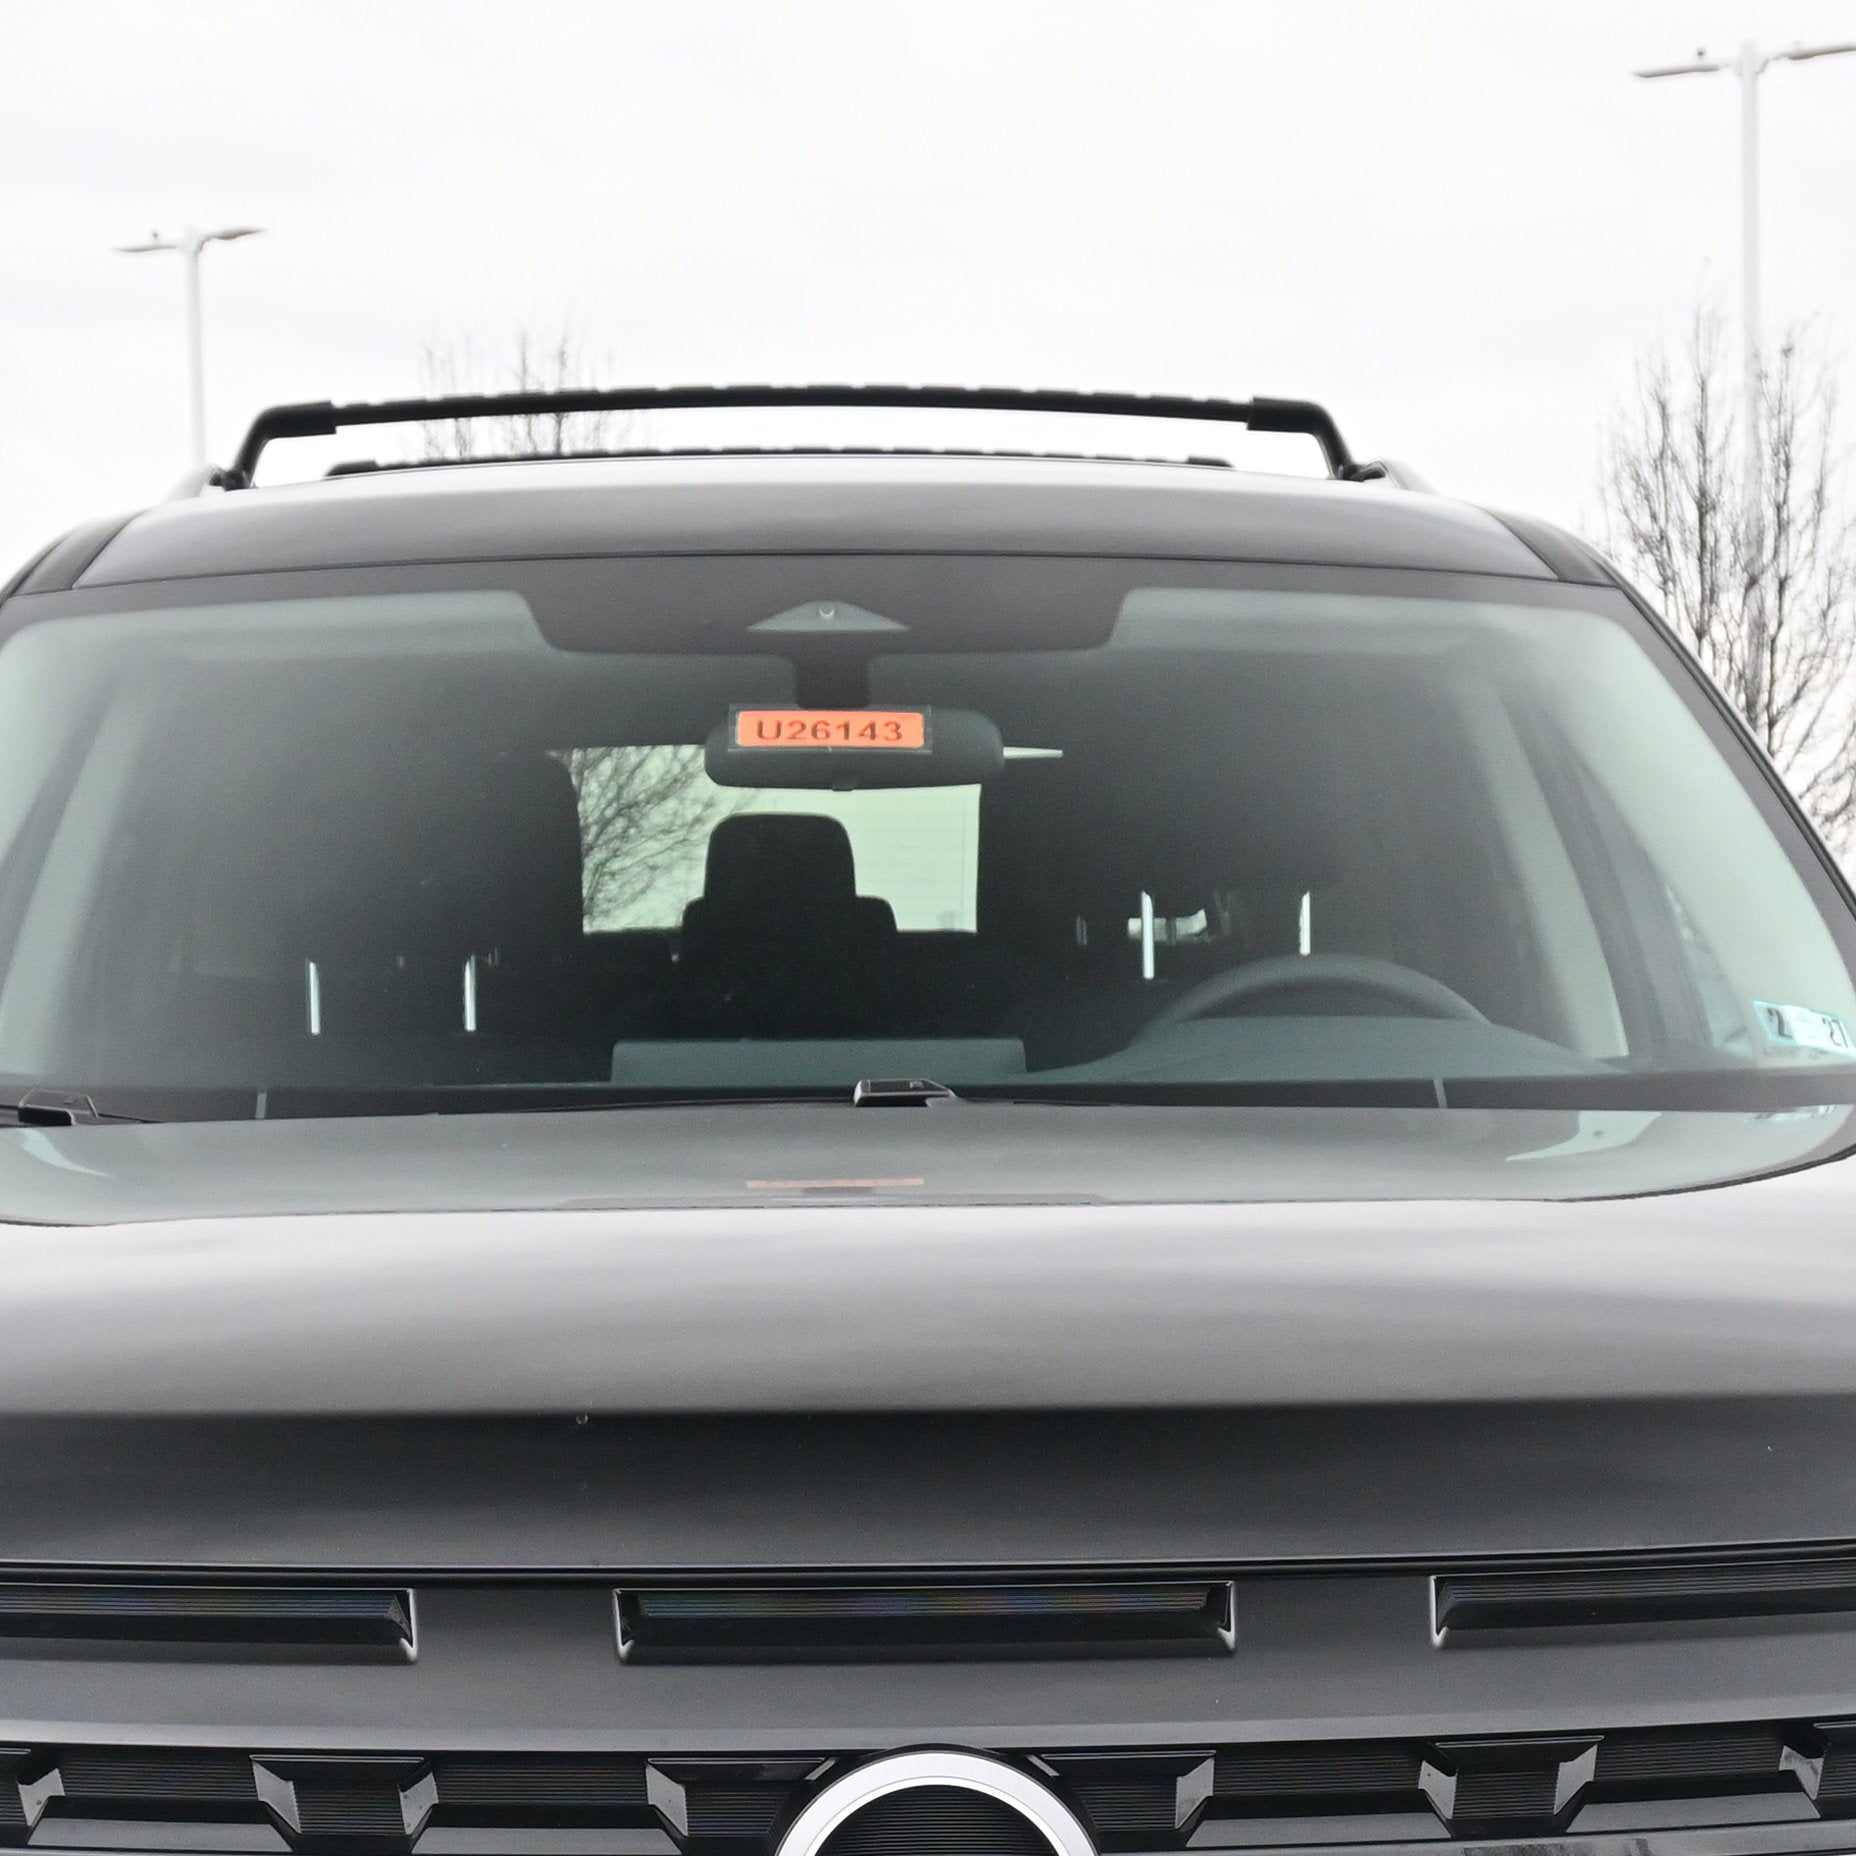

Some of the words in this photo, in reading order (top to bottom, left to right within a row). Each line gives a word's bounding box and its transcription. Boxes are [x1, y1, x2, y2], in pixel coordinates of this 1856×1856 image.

[756, 719, 904, 742] U26143
[1766, 1007, 1793, 1040] 2
[1821, 1017, 1849, 1049] 27
